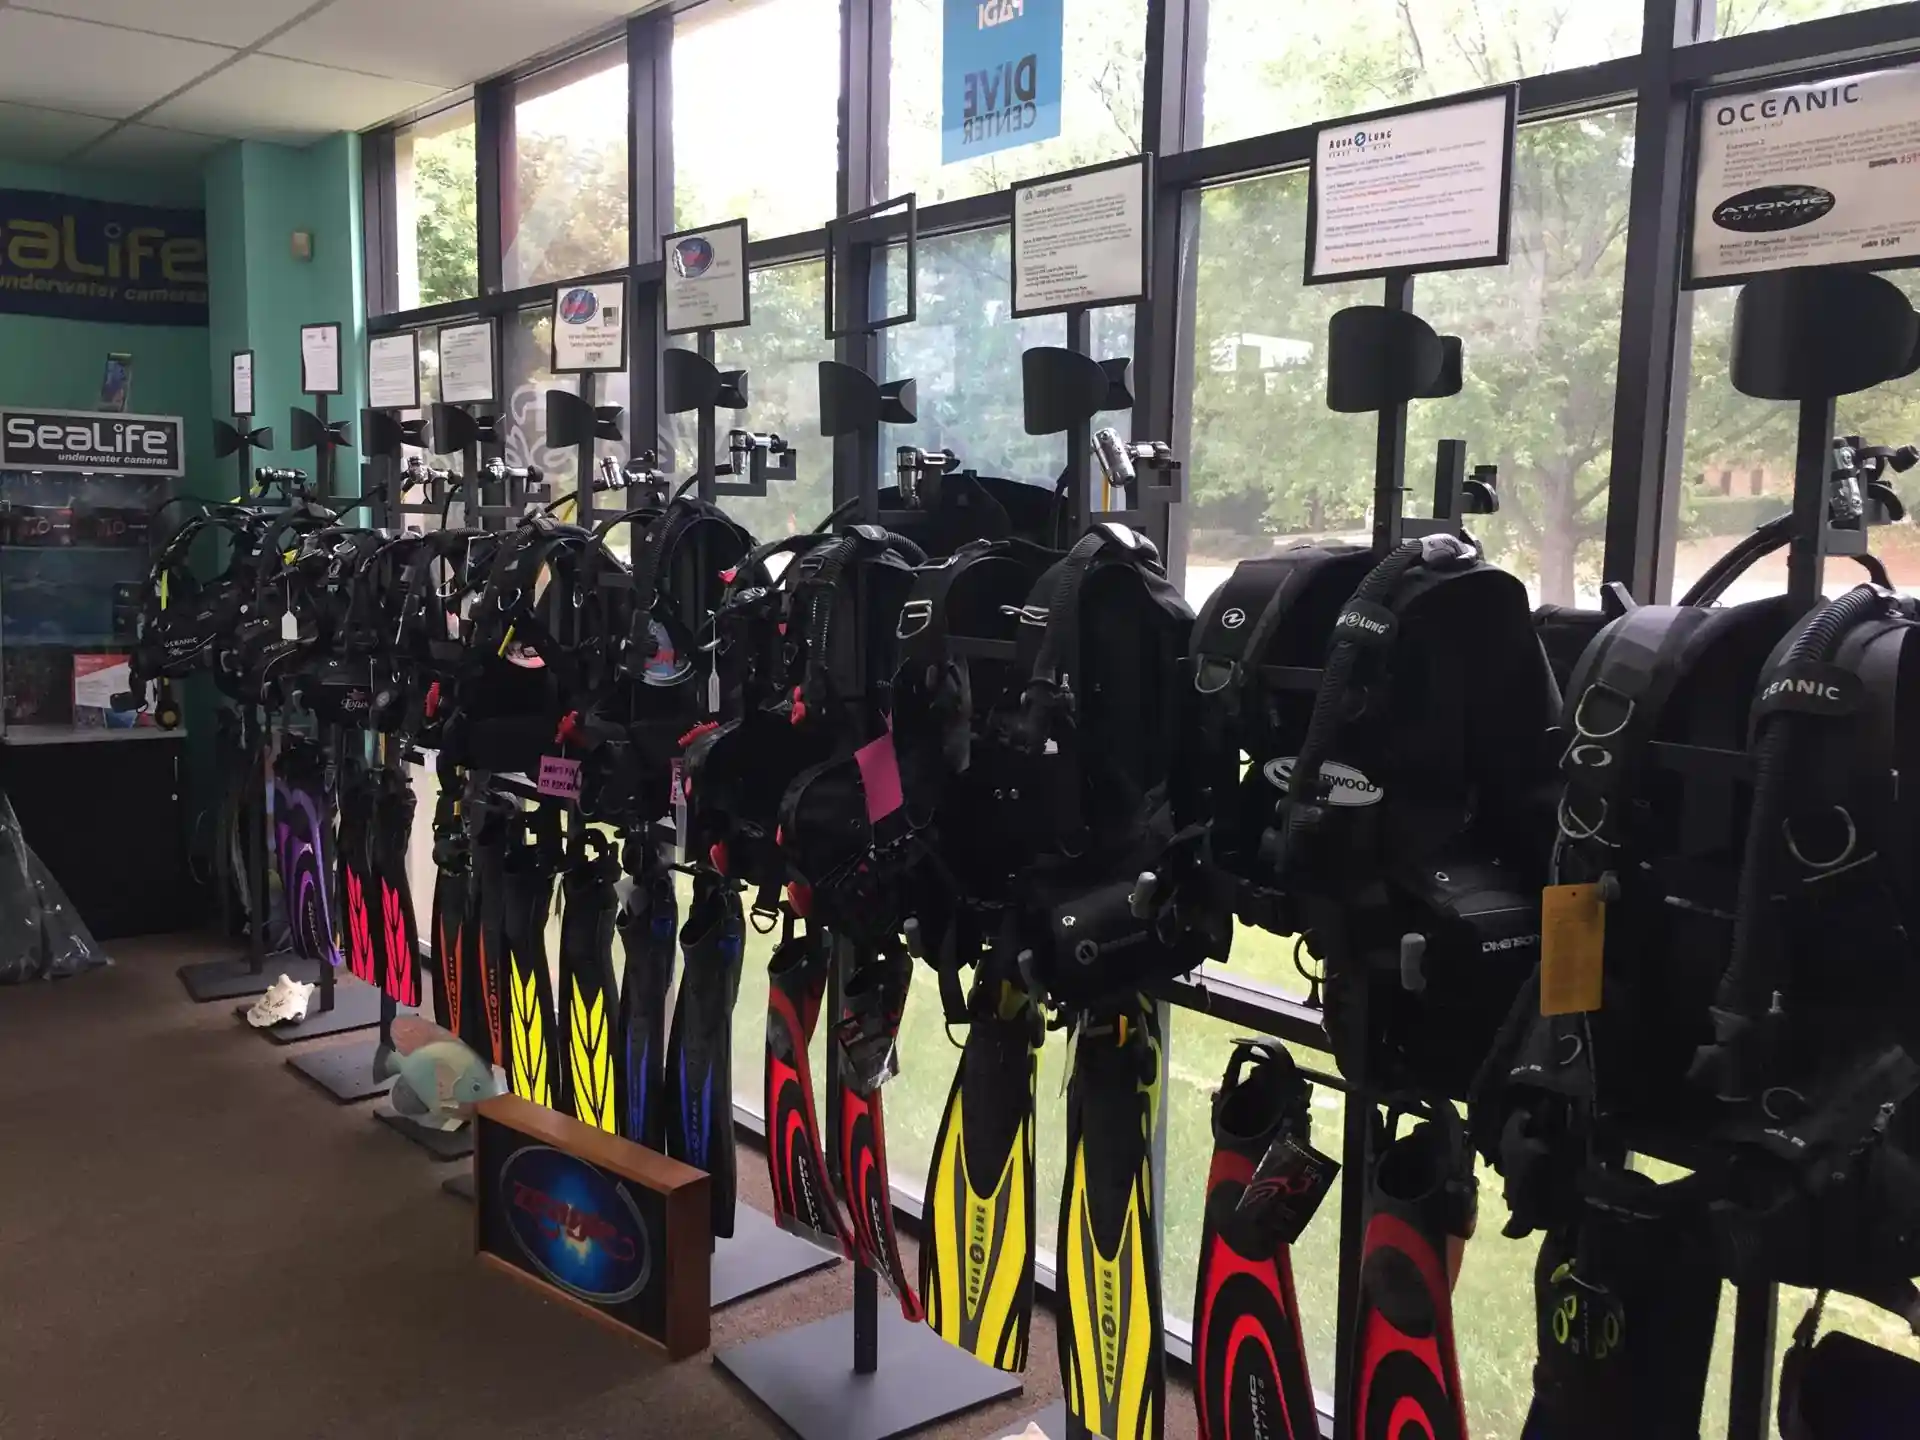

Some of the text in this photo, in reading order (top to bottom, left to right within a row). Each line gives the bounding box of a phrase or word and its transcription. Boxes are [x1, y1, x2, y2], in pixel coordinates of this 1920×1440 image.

[1717, 83, 1859, 126] OCEANIC
[1720, 196, 1830, 215] ATOMIC
[0, 215, 207, 283] aLife
[124, 287, 207, 304] cameras
[7, 418, 168, 455] SeaLife
[58, 452, 169, 466] underwater cameras
[1359, 616, 1387, 635] LUNG
[1761, 678, 1841, 701] CEANIC
